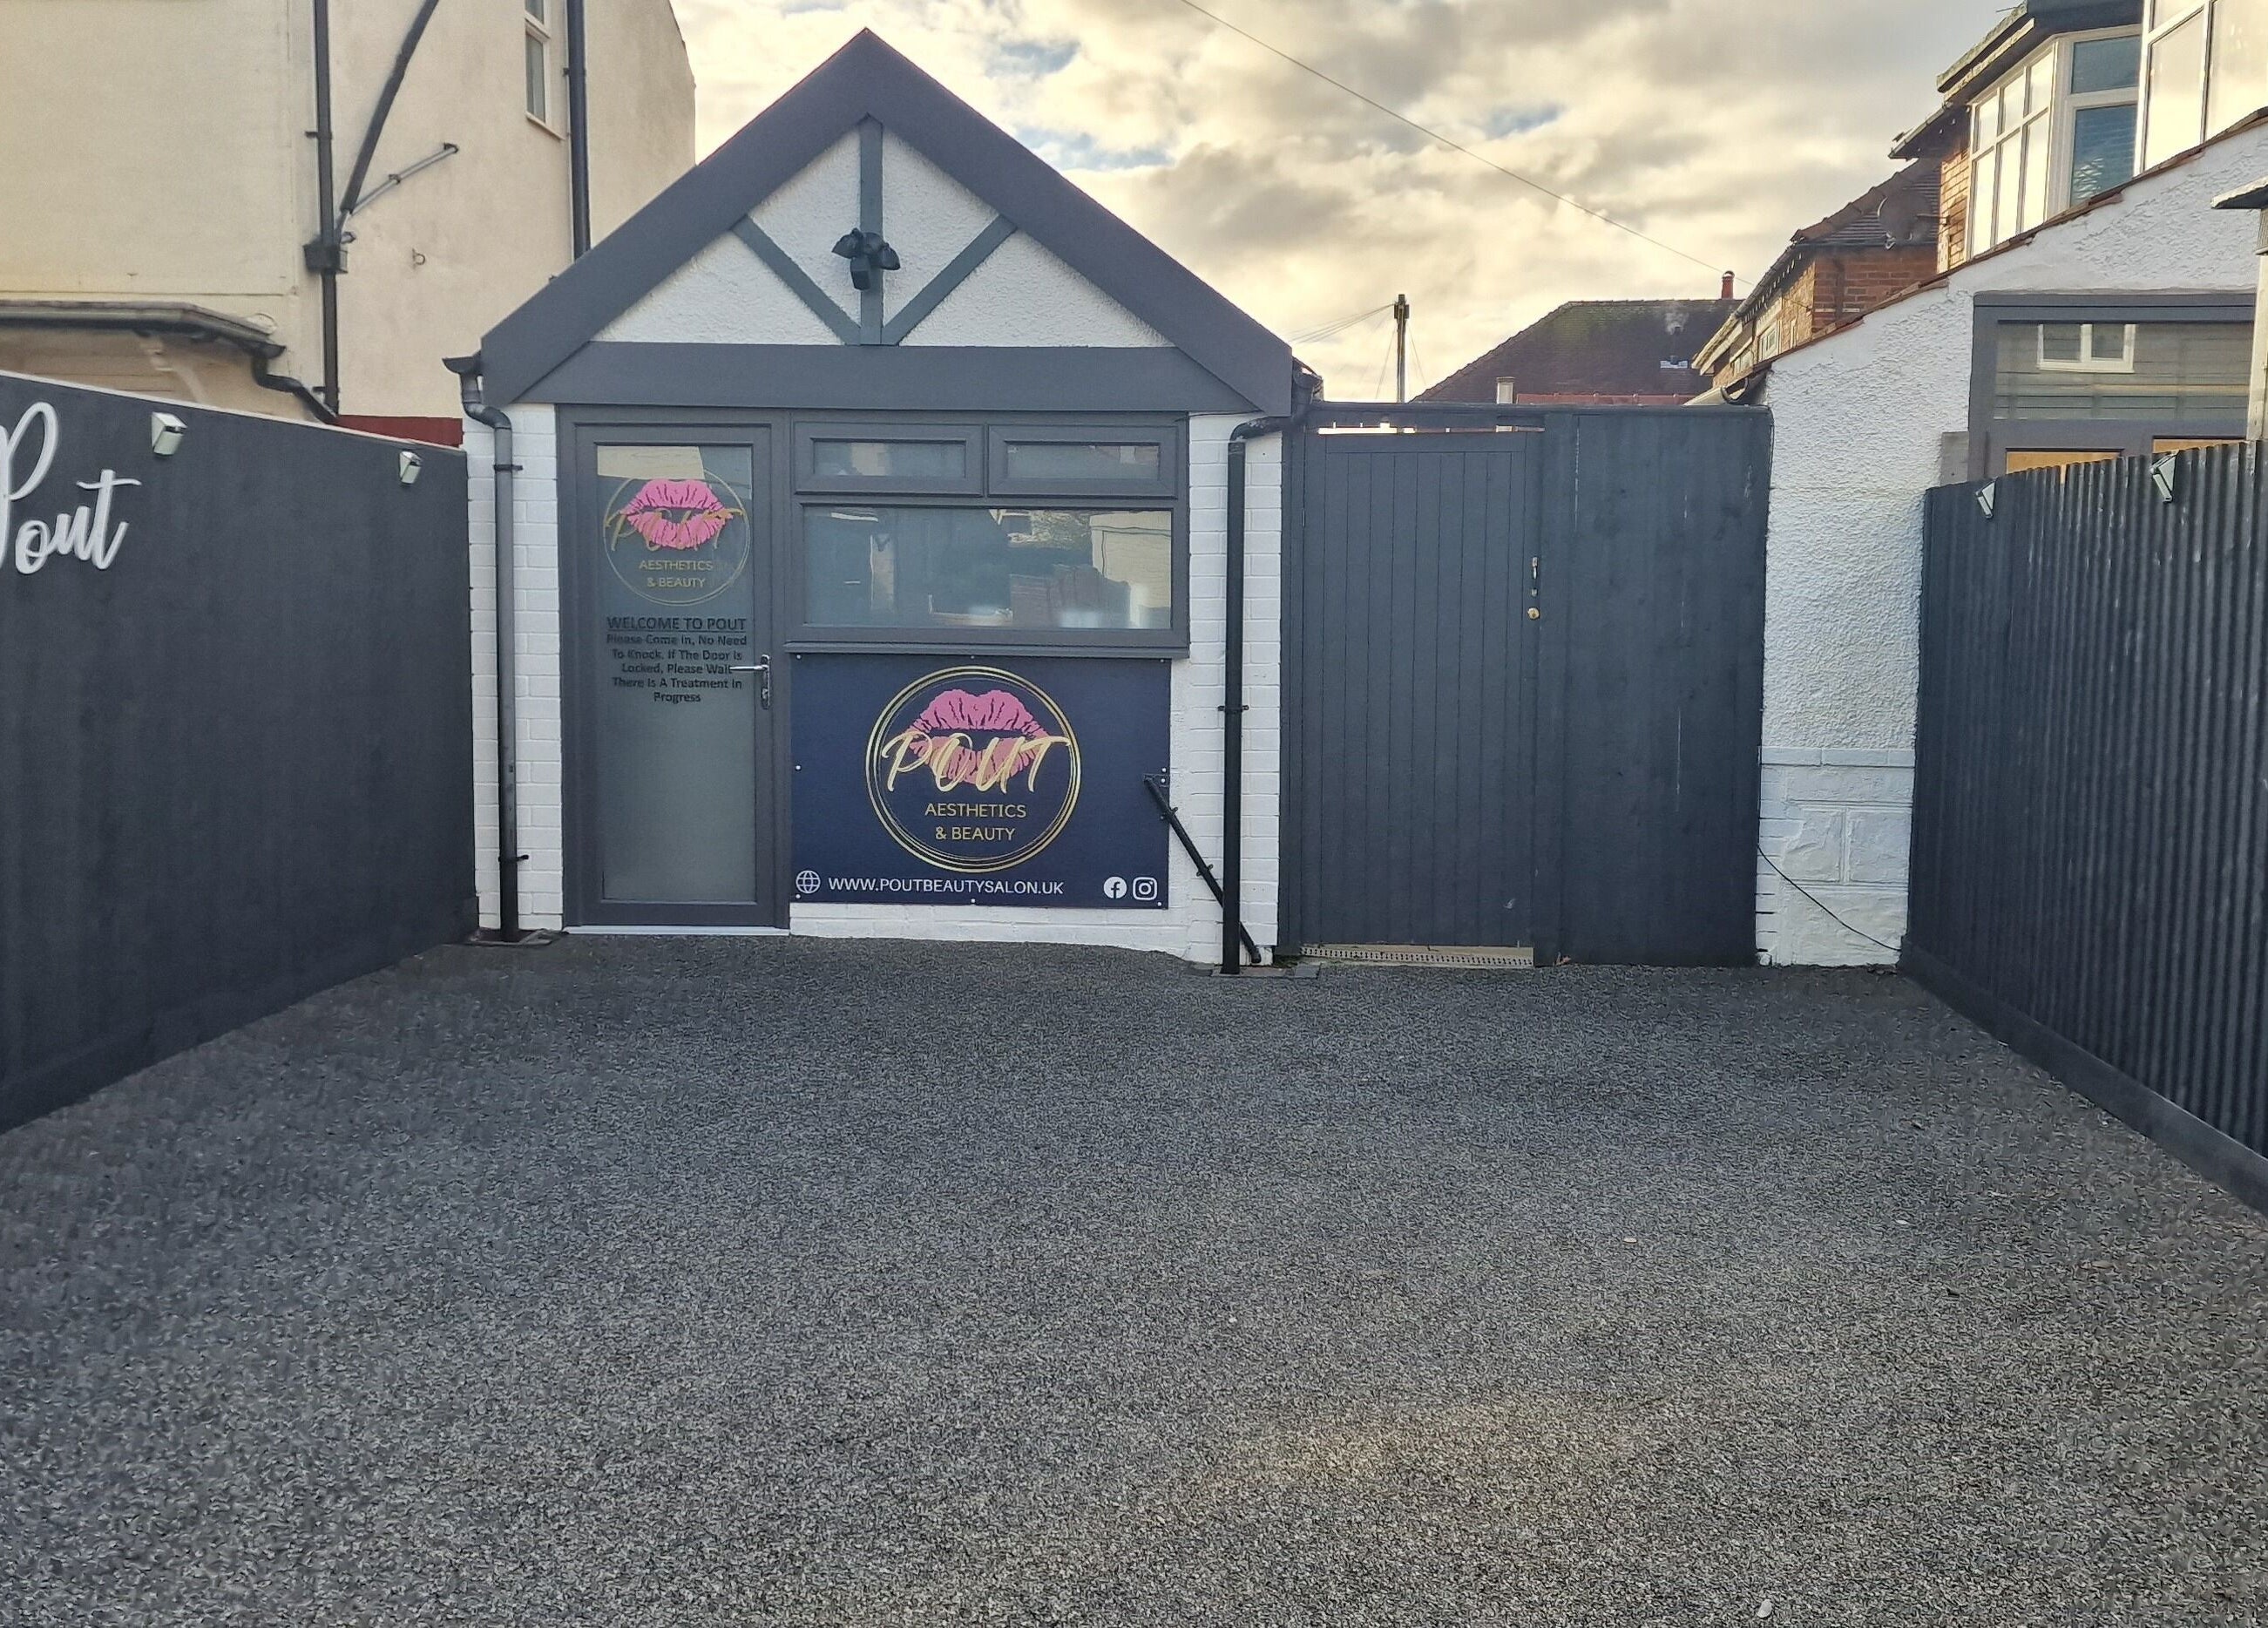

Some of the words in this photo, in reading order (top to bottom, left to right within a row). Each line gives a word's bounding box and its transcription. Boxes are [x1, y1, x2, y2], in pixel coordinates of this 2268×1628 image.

[640, 560, 714, 571] AESTHETICS
[647, 578, 656, 587] &
[660, 578, 706, 587] BEAUTY
[606, 617, 680, 630] WELCOME
[684, 617, 703, 630] TO
[707, 618, 747, 630] POUT
[606, 634, 643, 644] Please
[646, 634, 676, 644] Come
[681, 635, 695, 646] In,
[698, 635, 714, 645] No
[717, 635, 747, 646] Need
[613, 649, 625, 659] To
[668, 649, 675, 659] If
[679, 650, 699, 660] The
[702, 650, 729, 660] Door
[621, 663, 663, 675] Locked,
[667, 664, 703, 674] Please
[706, 664, 733, 675] Wait
[613, 677, 644, 688] There
[647, 678, 656, 688] Is
[660, 678, 667, 688] A
[671, 678, 728, 689] Treatment
[732, 679, 742, 689] In
[653, 692, 701, 704] Progress
[882, 731, 1072, 794] POUT
[924, 803, 1026, 817] AESTHETICS
[935, 827, 947, 840] &
[951, 827, 1016, 840] BEAUTY
[829, 878, 1064, 895] WWW.POUTBEAUTYSALON.UK
